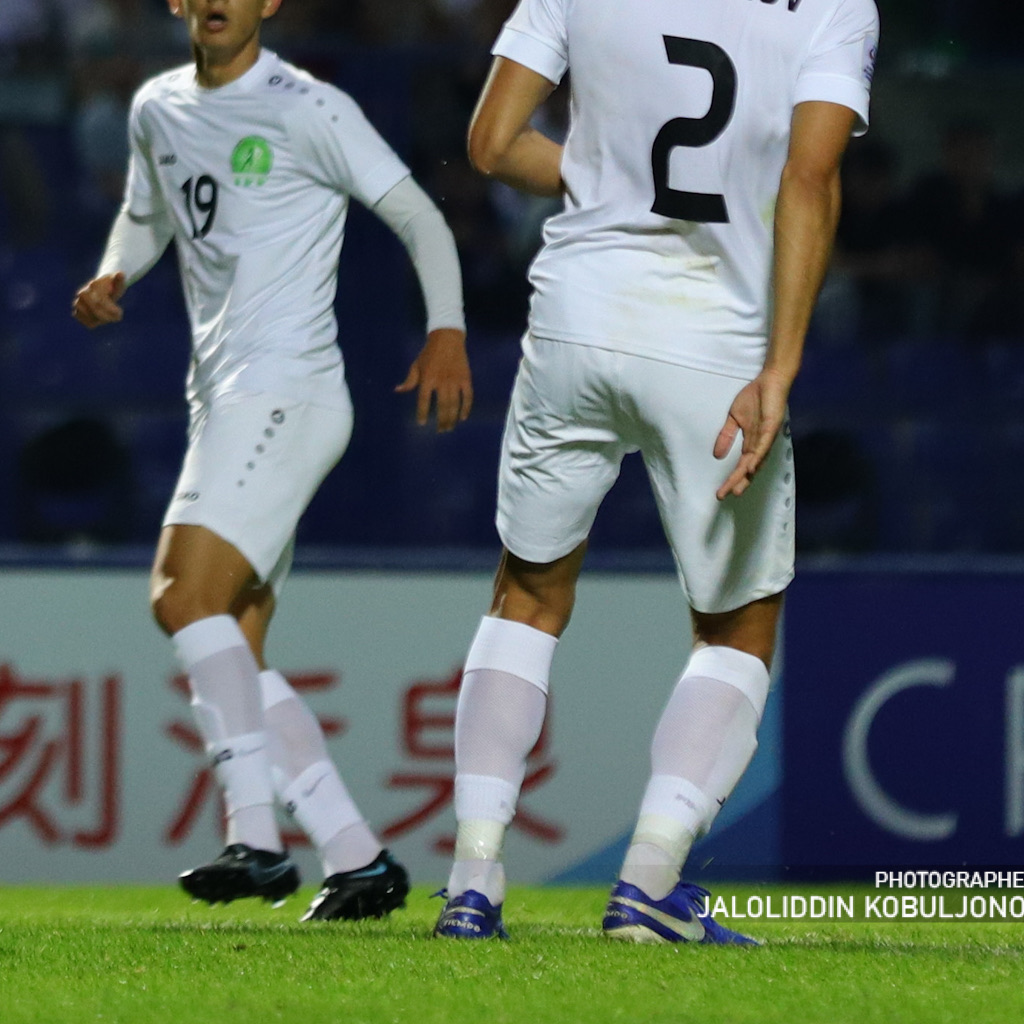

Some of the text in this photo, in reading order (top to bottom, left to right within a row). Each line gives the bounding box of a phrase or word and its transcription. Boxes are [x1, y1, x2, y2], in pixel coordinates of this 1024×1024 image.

[181, 174, 218, 240] 19
[650, 34, 738, 224] 2
[842, 658, 1024, 842] C
